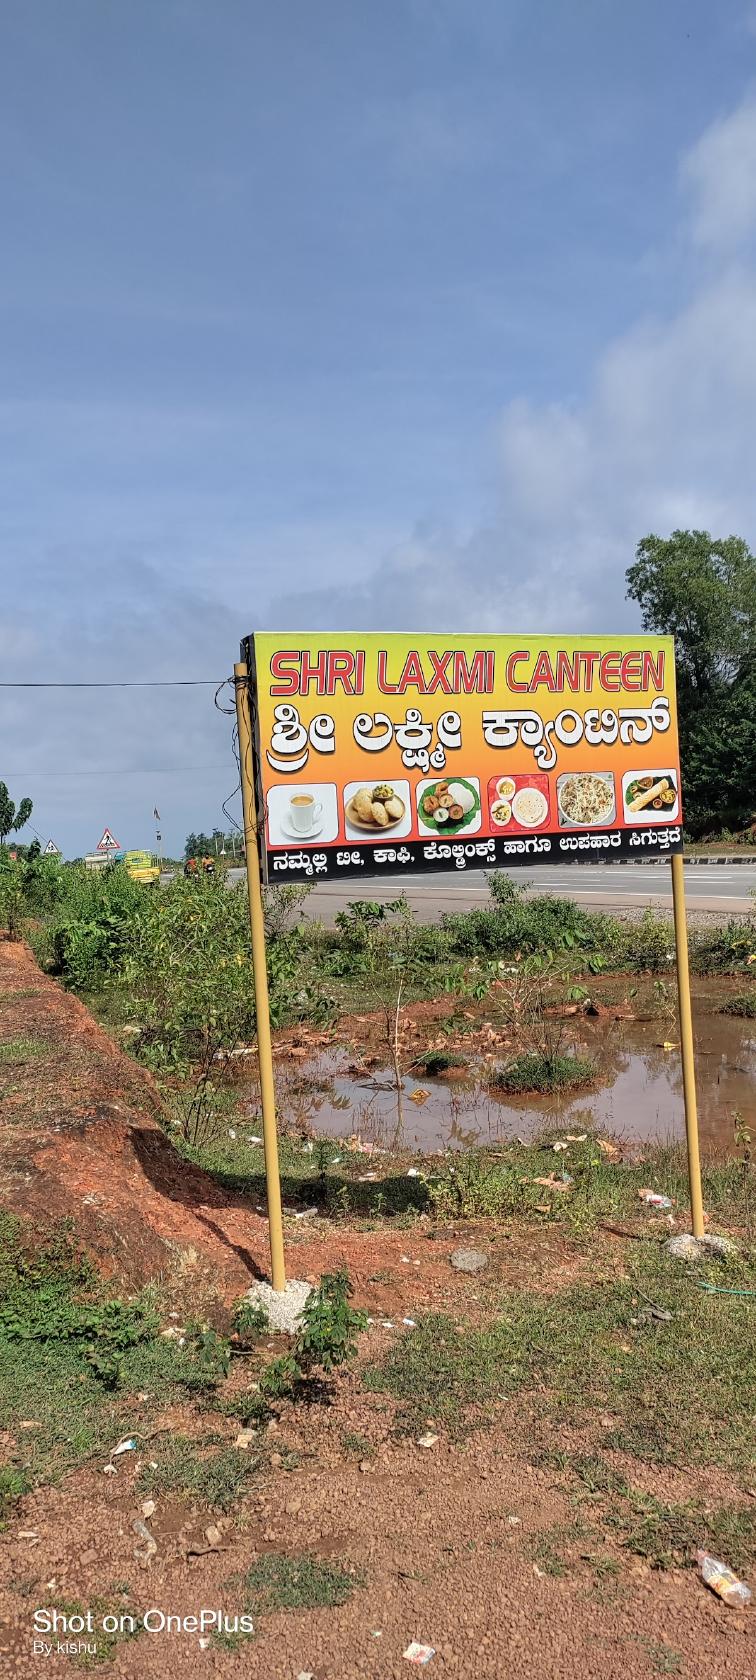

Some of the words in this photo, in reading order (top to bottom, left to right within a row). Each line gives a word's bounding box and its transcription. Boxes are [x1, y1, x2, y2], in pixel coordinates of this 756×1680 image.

[270, 651, 366, 696] SHRI
[377, 651, 494, 695] LAXMI
[506, 650, 665, 693] CANTEEN
[266, 703, 336, 773] ಶ್ರೀ
[353, 708, 462, 774] ಲಕ್ಷ್ಮೀ
[482, 696, 671, 770] ಕ್ಯಾಂಟಿನ್
[273, 851, 328, 876] ನಮ್ಮಲ್ಲಿ
[503, 835, 552, 854] ಹಾಗೂ
[559, 830, 622, 851] ಉಪಹಾರ
[629, 826, 681, 849] ಸಿಗುತ್ತದೆ
